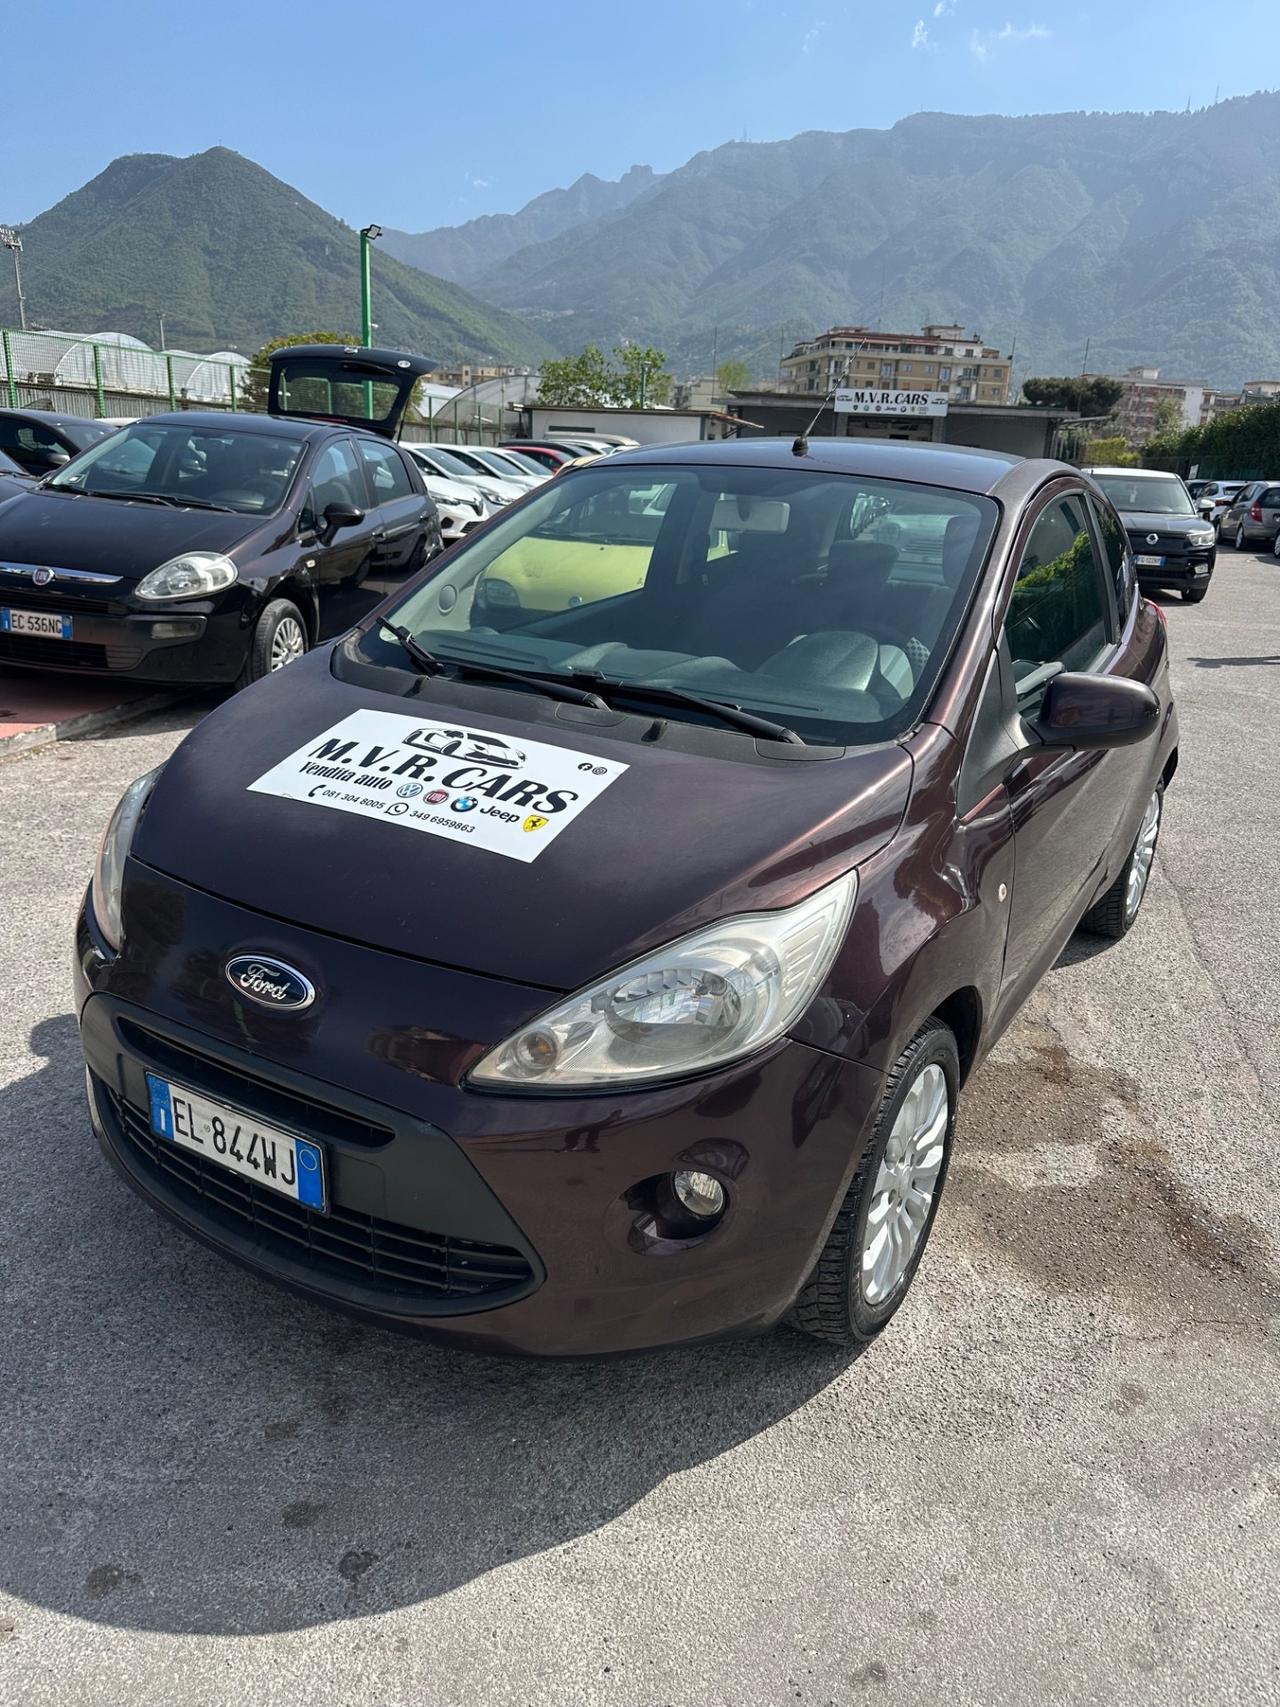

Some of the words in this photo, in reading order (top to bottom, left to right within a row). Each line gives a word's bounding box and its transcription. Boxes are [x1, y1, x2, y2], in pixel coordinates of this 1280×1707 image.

[11, 614, 24, 630] EC
[299, 761, 356, 782] Vendita
[353, 774, 393, 790] auto
[322, 789, 341, 799] 081
[341, 793, 361, 803] 304
[360, 798, 386, 809] 8005
[409, 810, 431, 822] 349
[430, 815, 476, 833] 6959863
[480, 805, 521, 824] Jeep
[240, 963, 293, 1000] Ford
[173, 1096, 204, 1144] EL
[211, 1116, 296, 1185] 844WJ
